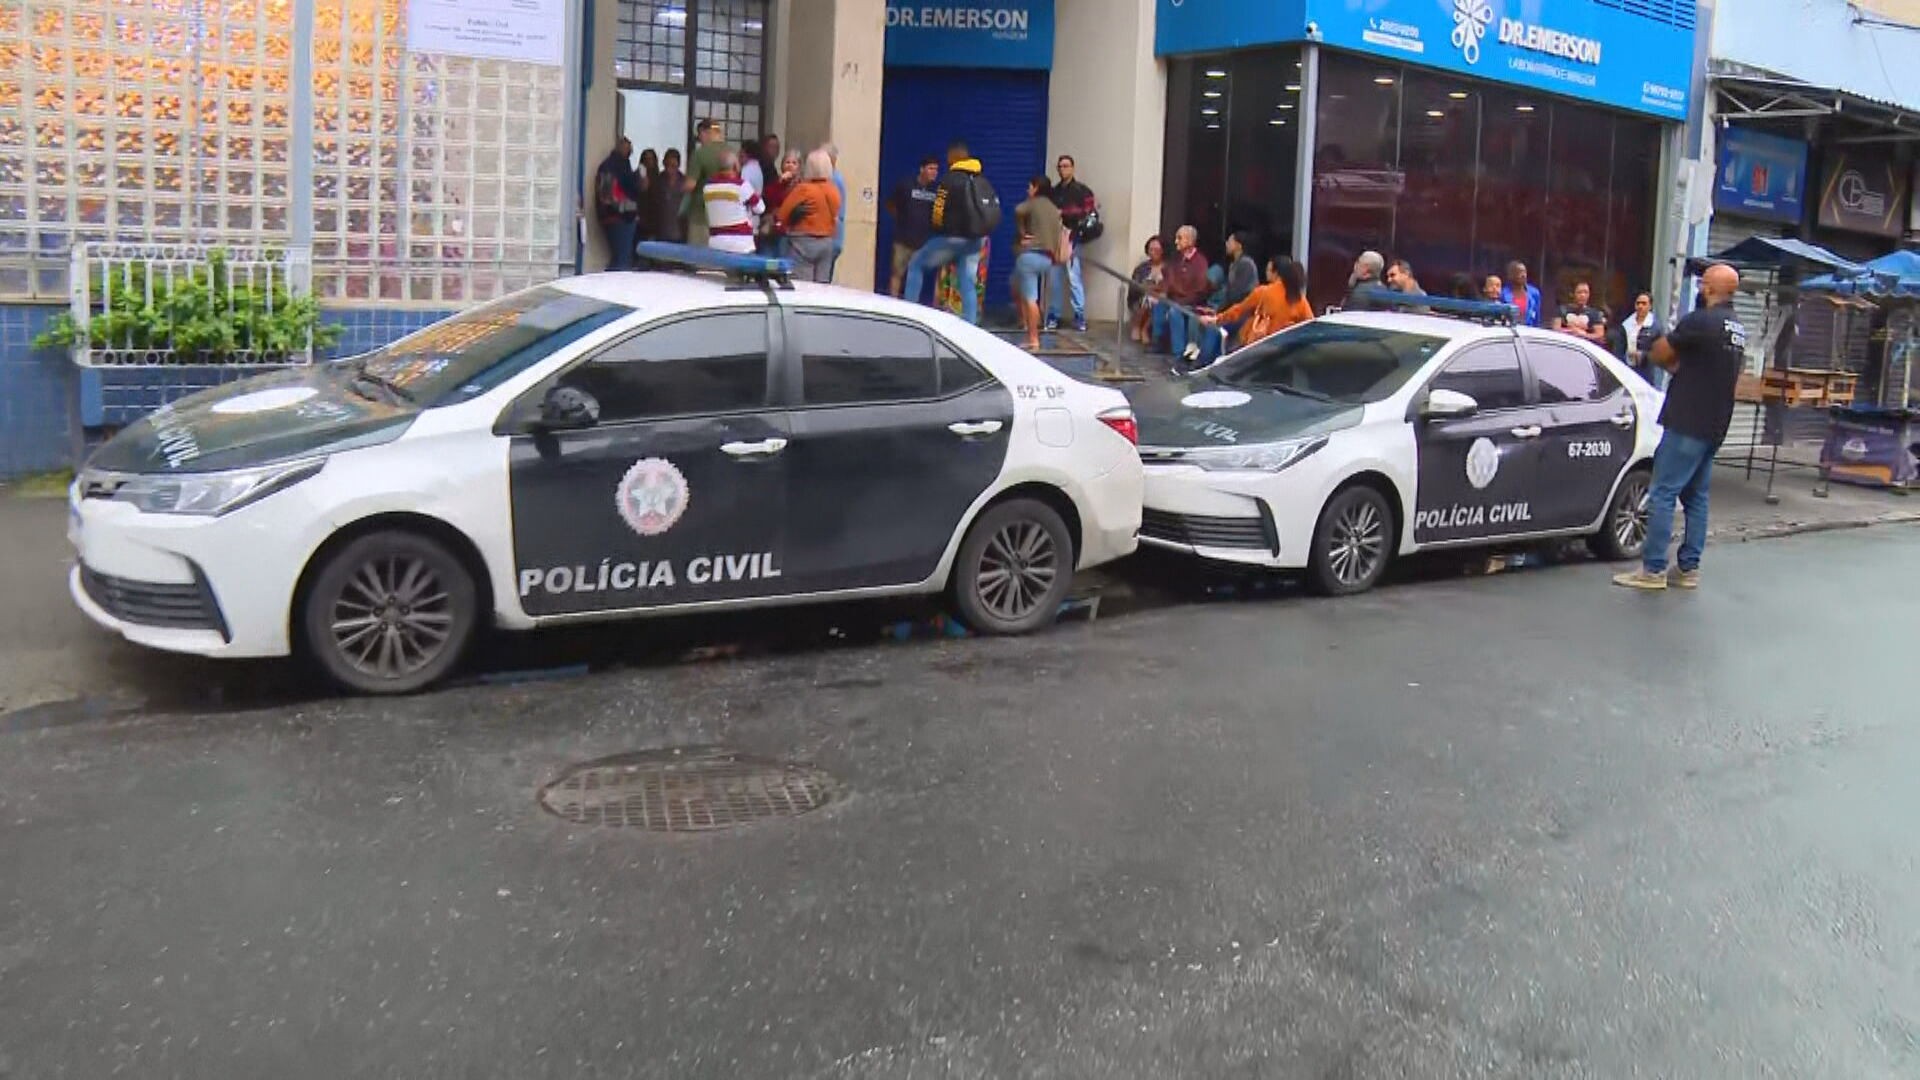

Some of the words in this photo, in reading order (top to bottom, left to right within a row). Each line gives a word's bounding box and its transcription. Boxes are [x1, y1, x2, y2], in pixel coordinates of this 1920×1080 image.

[886, 7, 1028, 30] DR.EMERSON
[1499, 17, 1601, 65] DR.EMERSON
[1568, 441, 1611, 458] 67-2030
[1415, 503, 1484, 529] POLÍCIA
[1489, 503, 1532, 523] CIVIL
[519, 557, 676, 597] POLÍCIA
[686, 552, 782, 585] CIVIL
